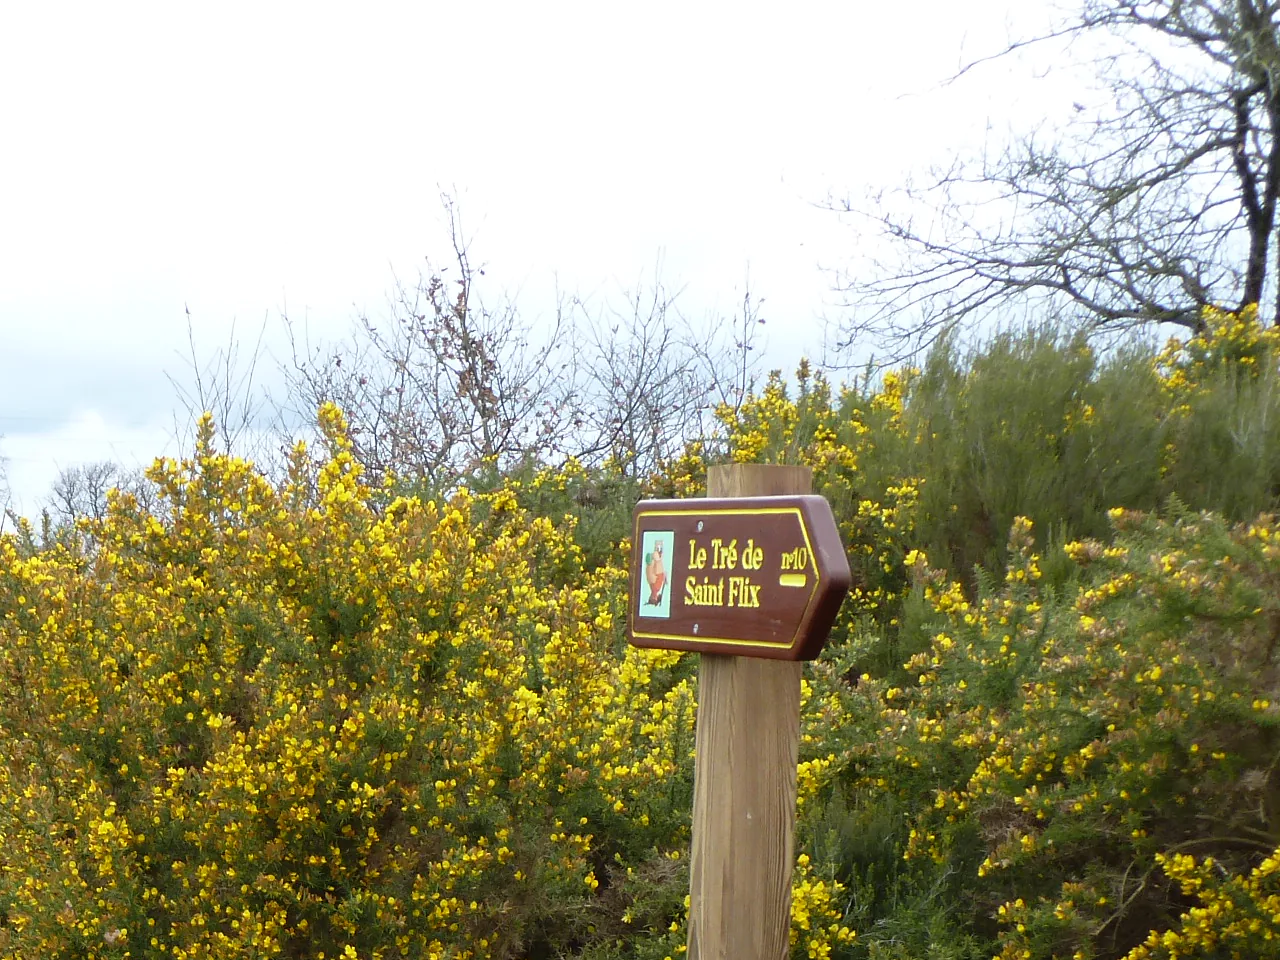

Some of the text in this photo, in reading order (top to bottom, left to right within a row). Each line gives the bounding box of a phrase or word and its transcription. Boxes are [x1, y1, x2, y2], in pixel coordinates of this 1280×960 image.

[688, 538, 764, 570] Le Tré de
[685, 576, 761, 608] Saint Flix
